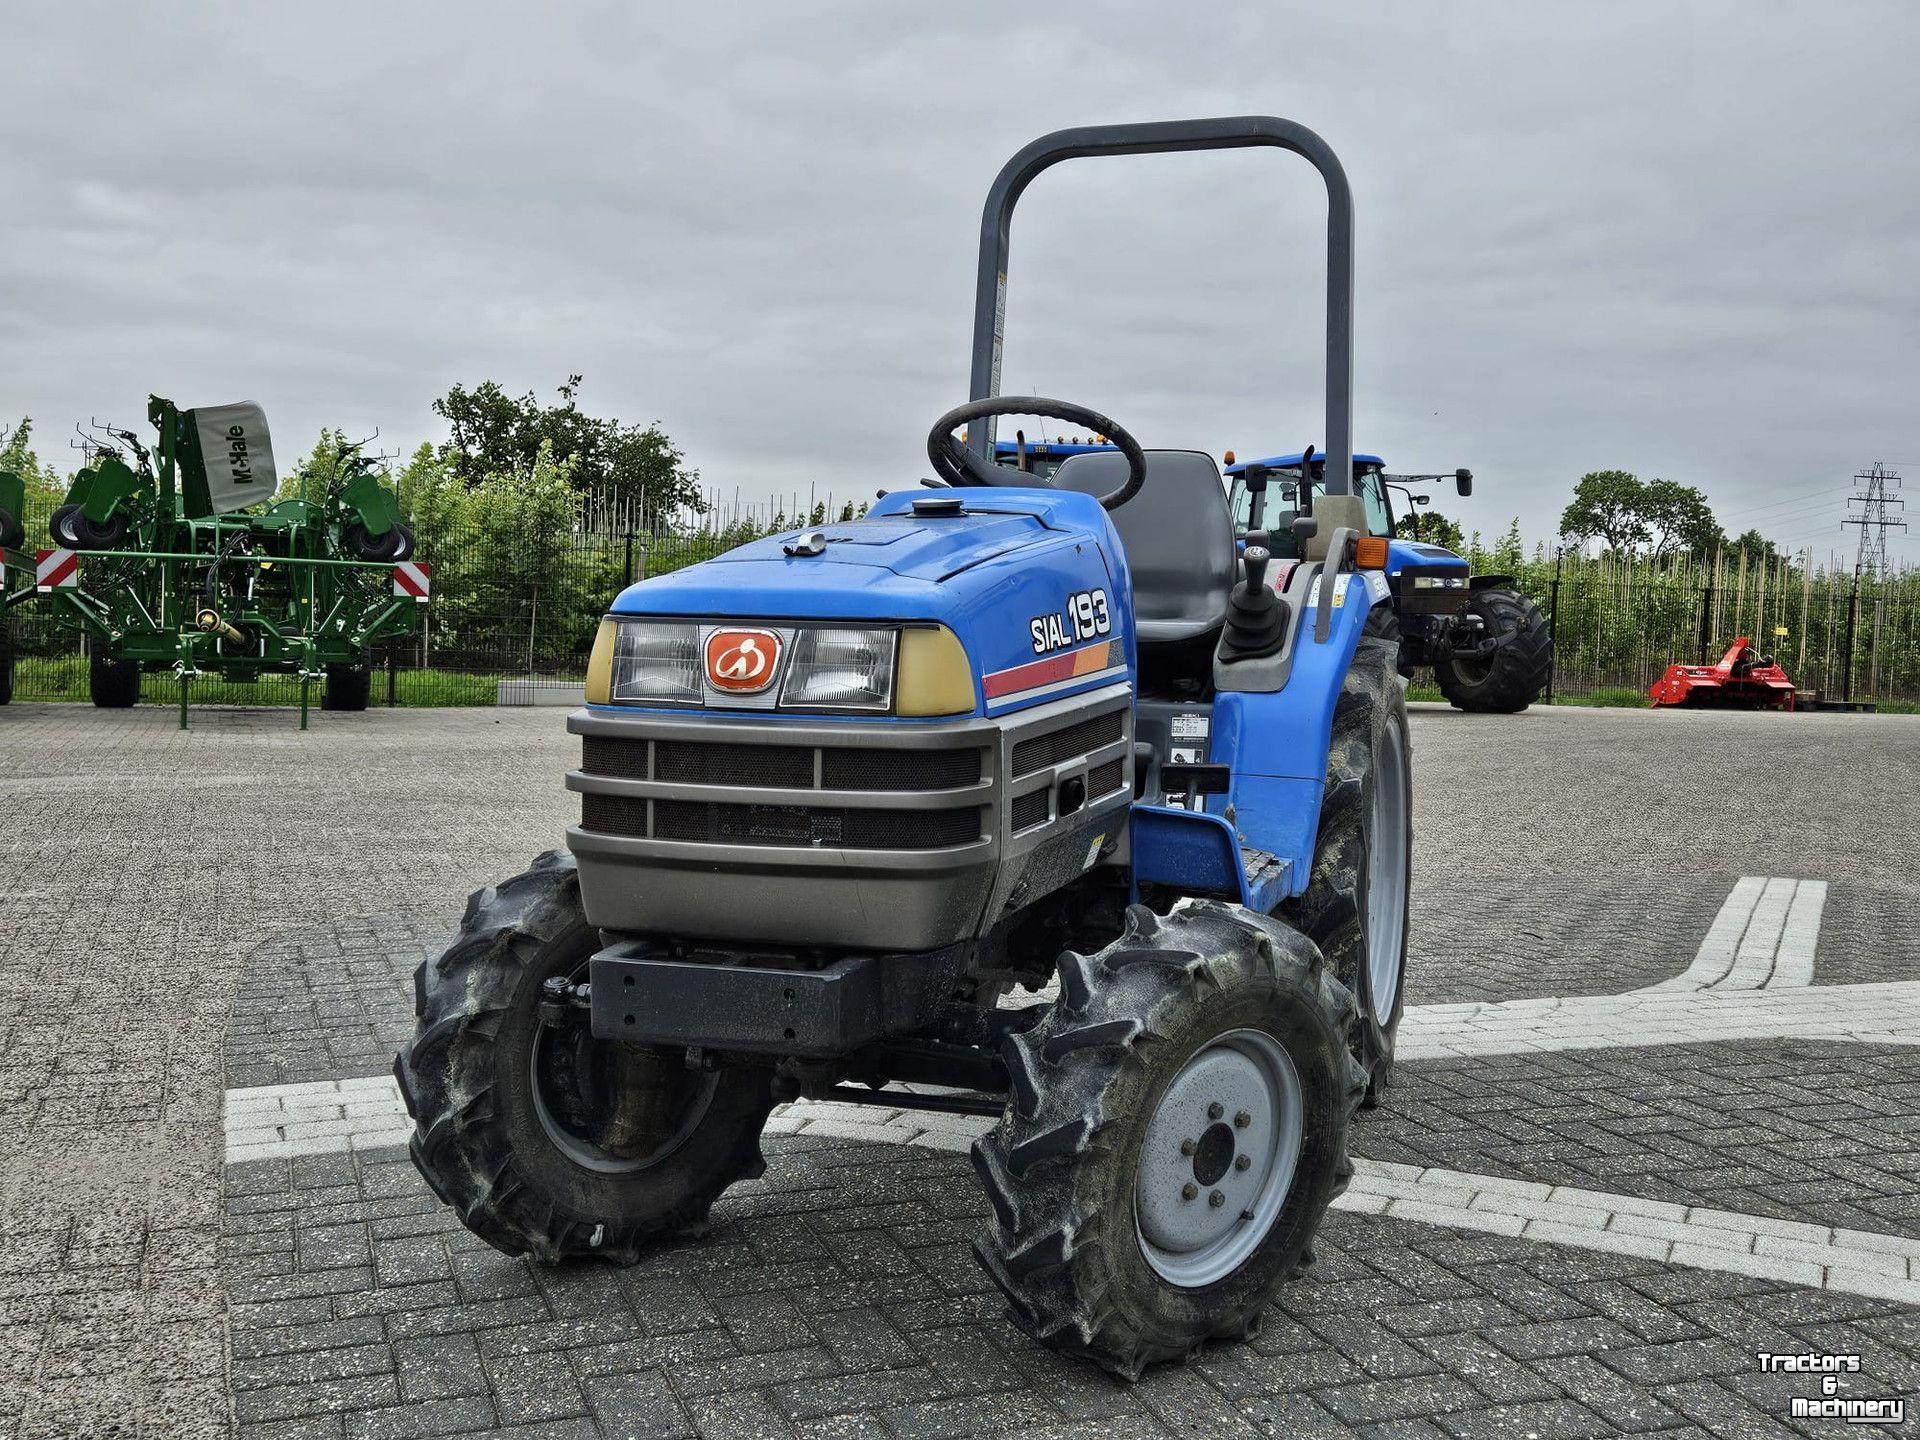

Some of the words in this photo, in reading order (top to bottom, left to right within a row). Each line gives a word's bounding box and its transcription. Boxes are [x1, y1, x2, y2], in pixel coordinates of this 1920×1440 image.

[225, 425, 253, 484] McHale
[1030, 612, 1072, 655] SIAL
[1067, 587, 1111, 643] 193
